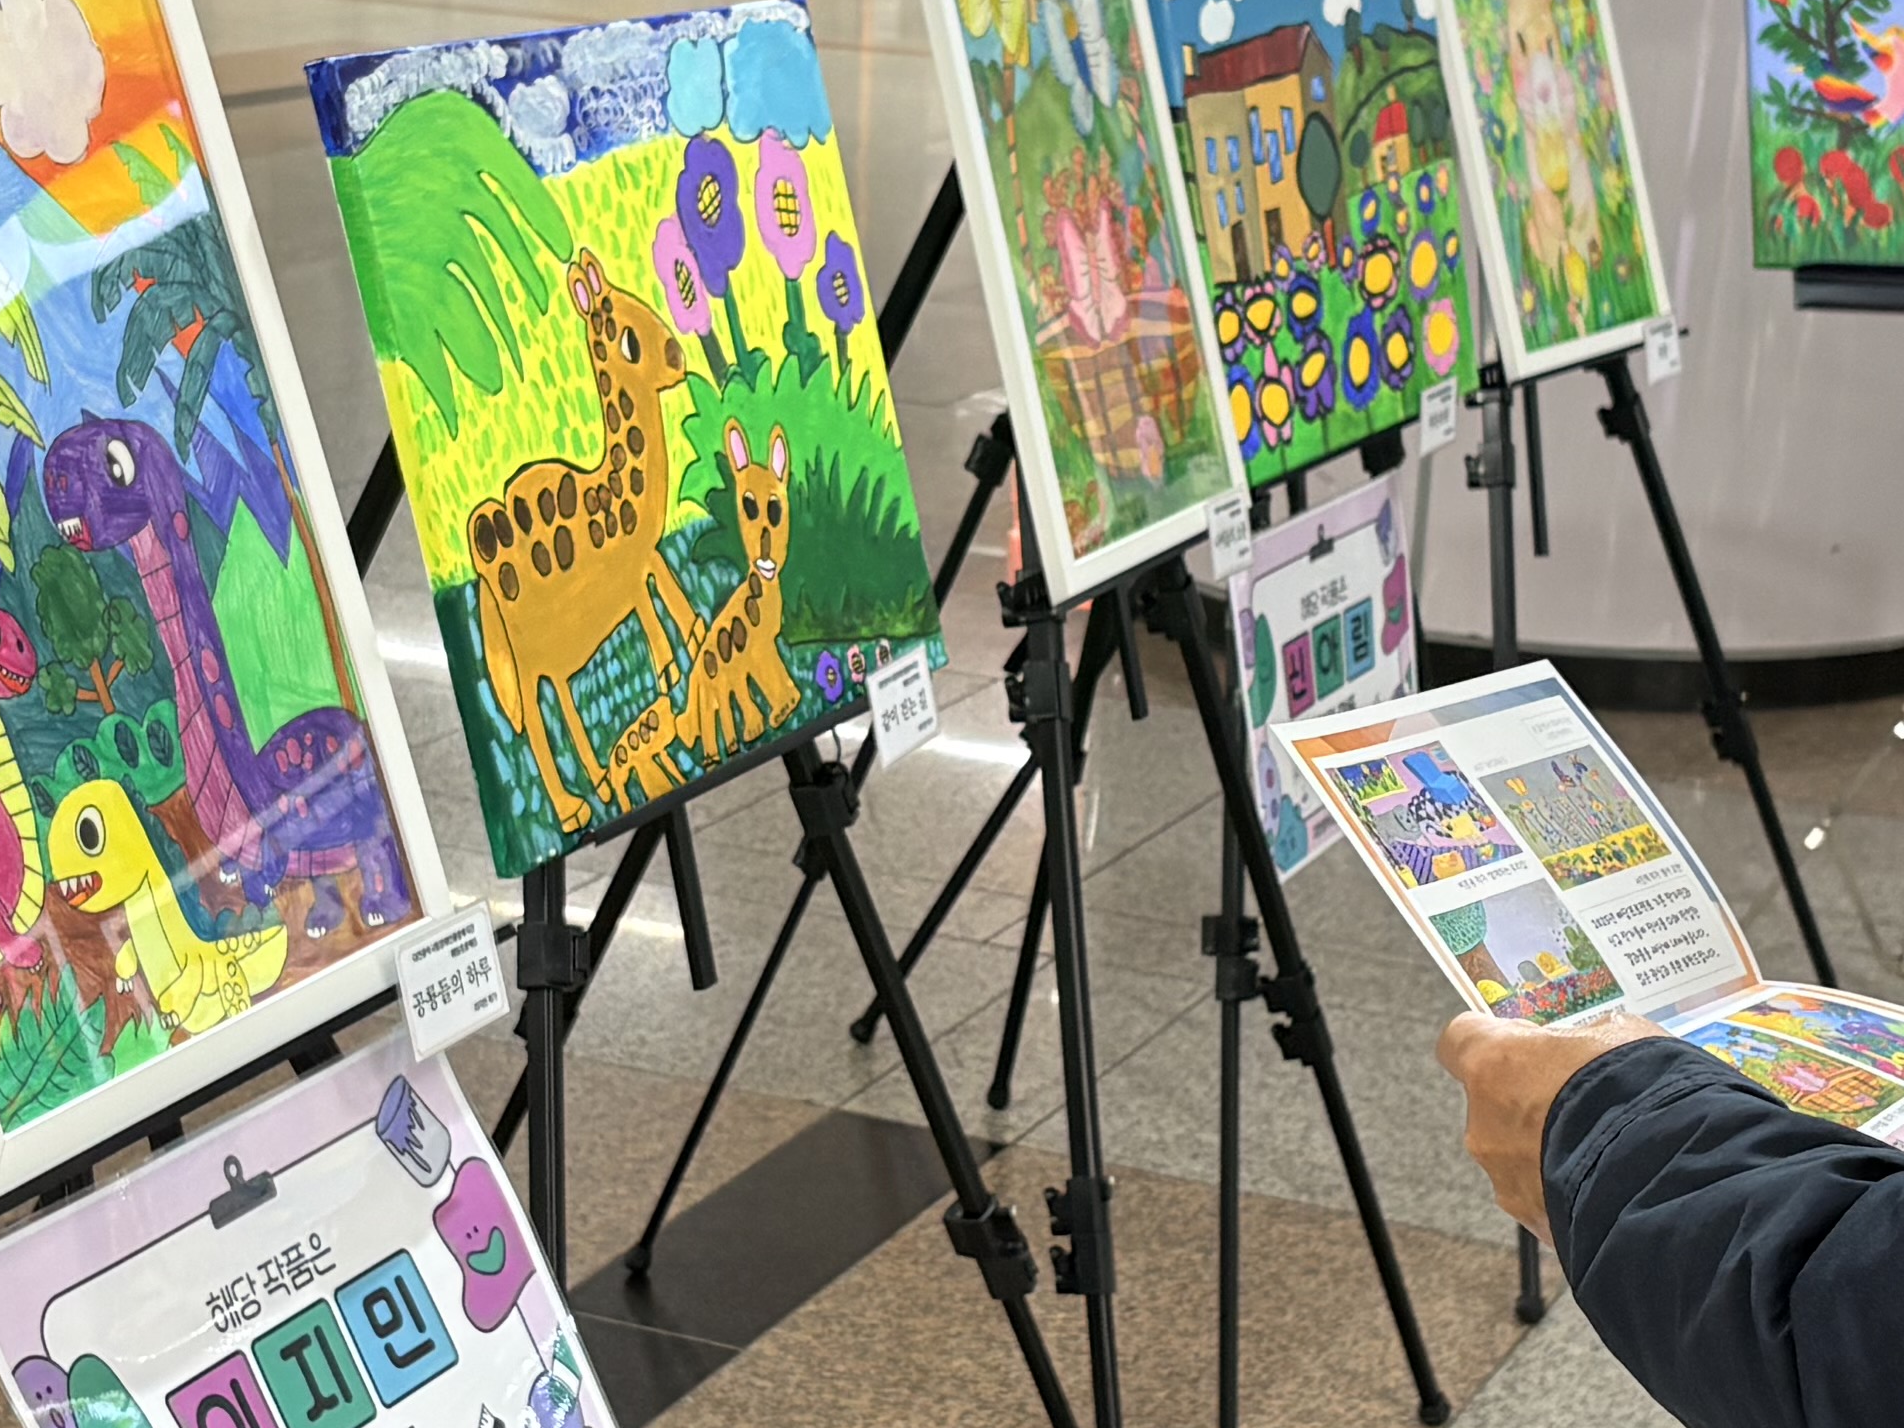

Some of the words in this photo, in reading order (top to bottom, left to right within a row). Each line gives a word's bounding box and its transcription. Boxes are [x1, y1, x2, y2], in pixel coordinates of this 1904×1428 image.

[465, 955, 492, 988] 하루
[205, 1272, 263, 1334] 해당
[257, 1232, 337, 1297] 작품은
